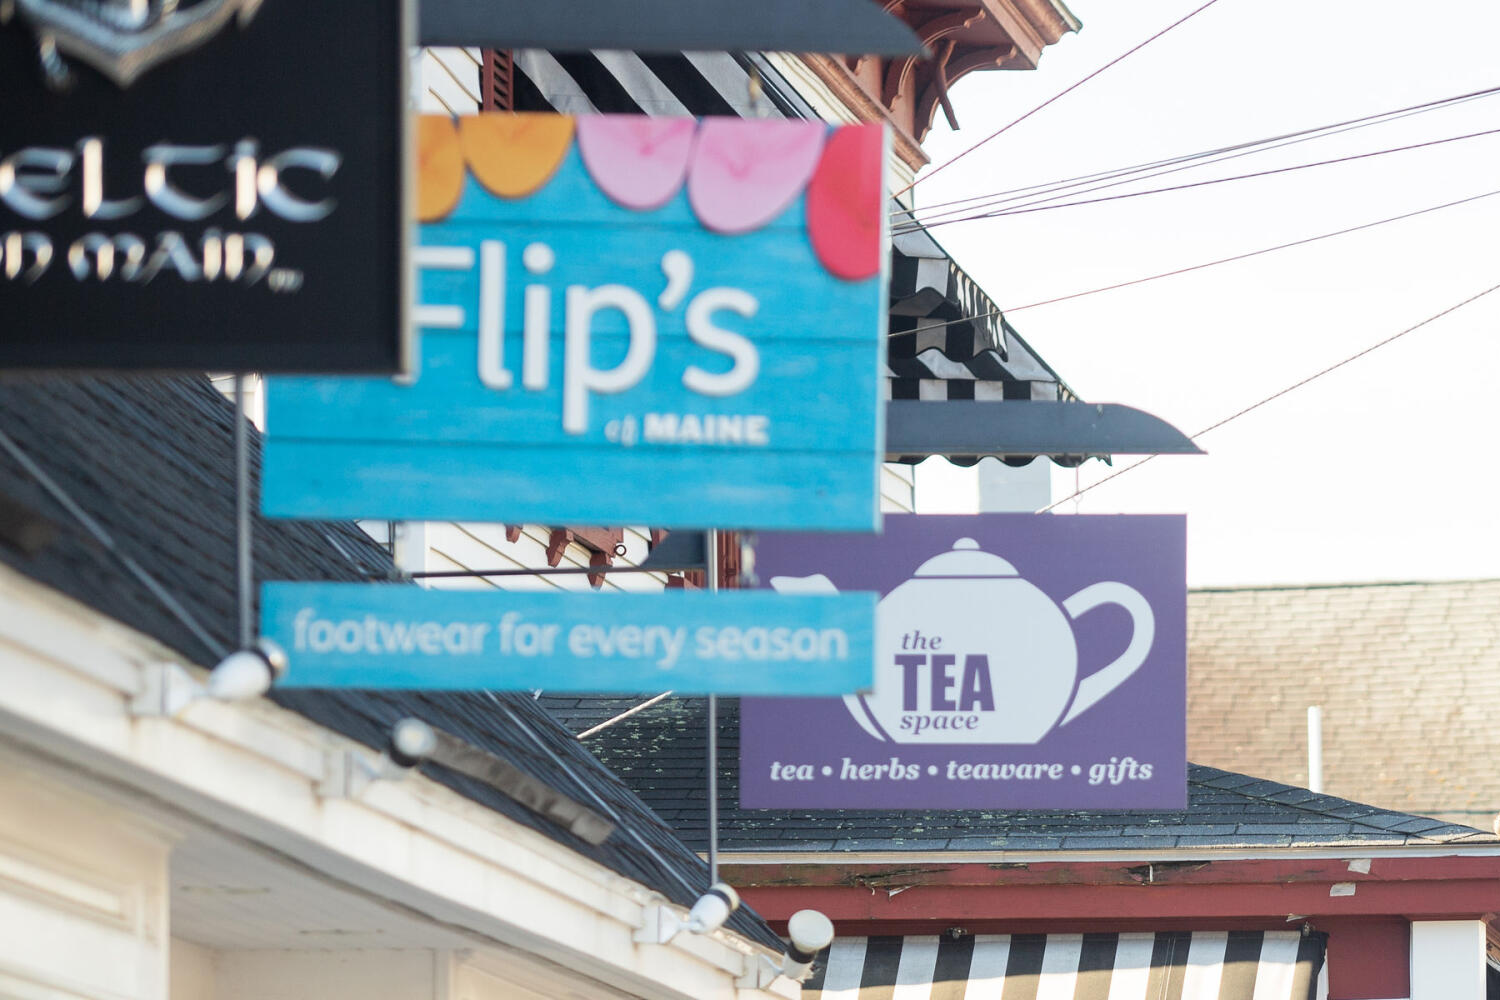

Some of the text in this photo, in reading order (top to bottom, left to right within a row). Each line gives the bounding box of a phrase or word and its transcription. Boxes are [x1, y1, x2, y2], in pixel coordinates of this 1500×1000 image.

[411, 239, 761, 435] Flip's
[643, 412, 770, 446] MAINE
[293, 608, 849, 670] footwear for every season
[902, 630, 942, 650] the
[894, 653, 996, 712] TEA
[899, 715, 980, 735] space
[770, 757, 1154, 786] tea herbs teaware gifts
